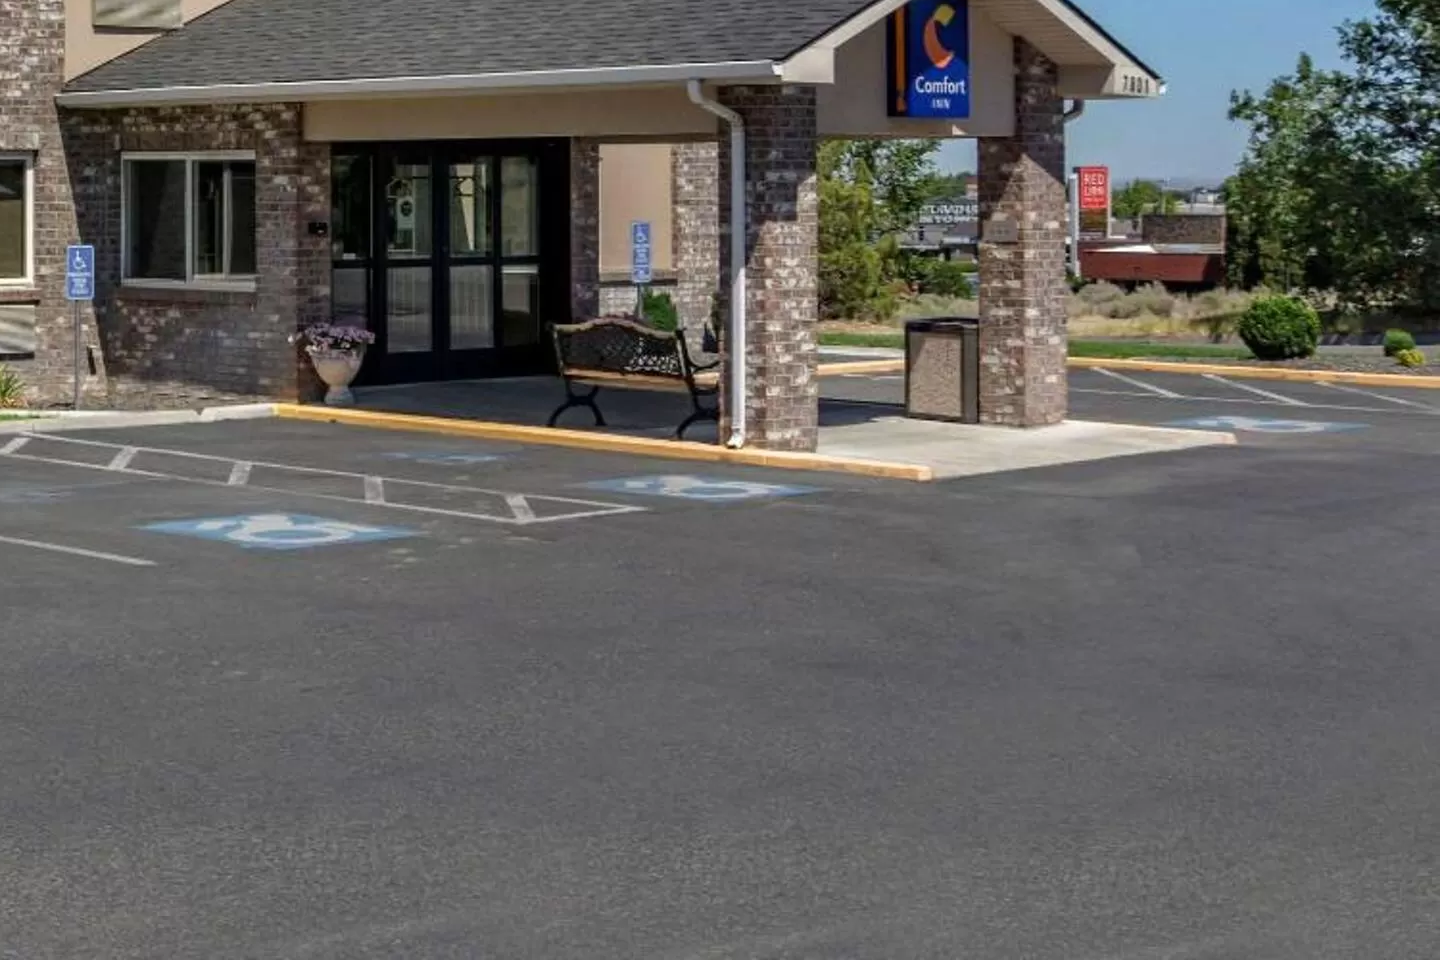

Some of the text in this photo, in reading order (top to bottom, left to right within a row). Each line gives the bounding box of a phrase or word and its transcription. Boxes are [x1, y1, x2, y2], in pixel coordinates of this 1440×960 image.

[914, 75, 966, 95] Comfort
[931, 98, 952, 110] INN
[1083, 172, 1105, 185] RED
